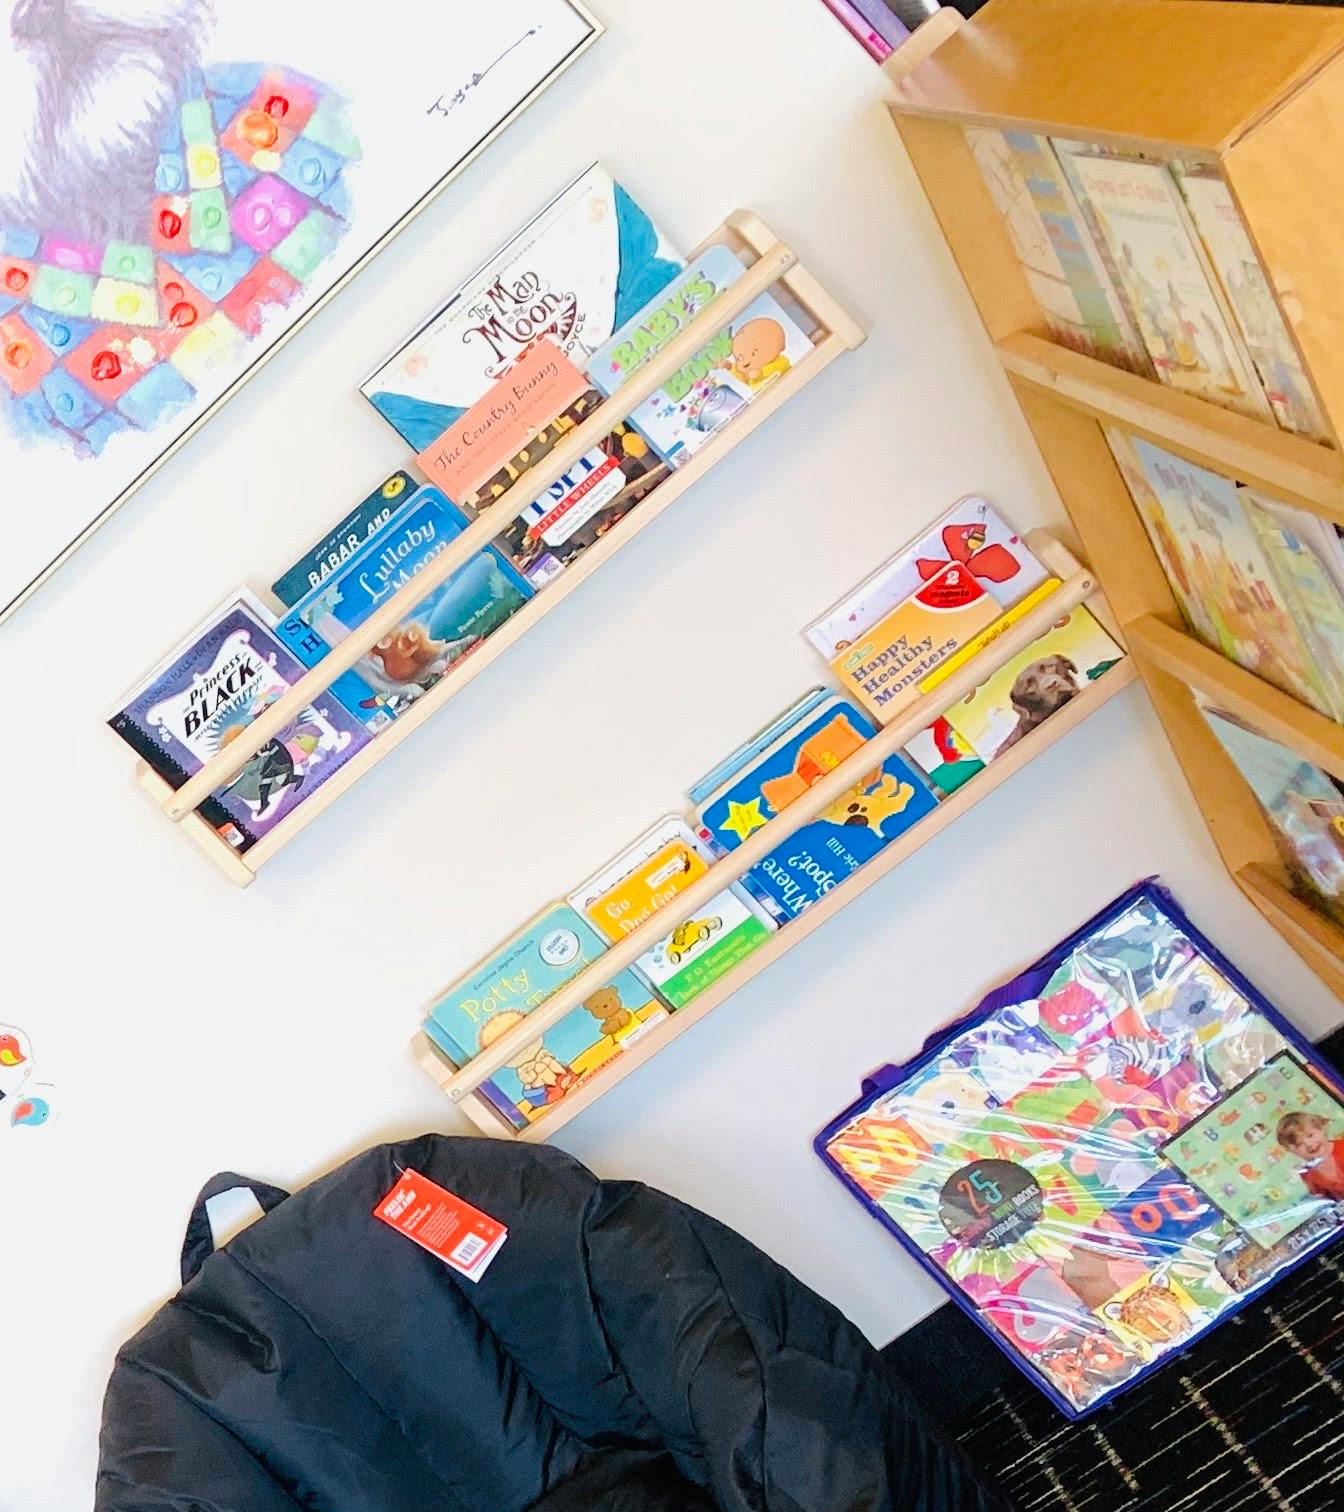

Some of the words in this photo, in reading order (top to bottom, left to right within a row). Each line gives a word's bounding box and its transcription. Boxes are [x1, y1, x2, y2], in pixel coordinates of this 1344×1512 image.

[485, 270, 543, 315] Man
[462, 289, 564, 361] Moon
[608, 272, 715, 373] BABY'S
[433, 446, 461, 471] The
[459, 398, 517, 446] Country
[512, 358, 558, 399] Bunny
[537, 498, 572, 531] LITTLE
[571, 463, 611, 500] WHEELS
[307, 533, 361, 587] BABAR
[366, 507, 391, 536] AND
[361, 517, 438, 602] Lullaby
[188, 654, 242, 705] Princess
[851, 633, 909, 683] Happy
[862, 634, 934, 694] Healthy
[873, 637, 958, 706] Monsters
[183, 656, 256, 738] BLACK
[825, 836, 844, 855] Hill
[604, 897, 631, 920] Go
[459, 966, 530, 1024] Potty
[955, 1167, 1004, 1214] 25
[1011, 1182, 1041, 1207] BOOKS
[985, 1214, 1021, 1242] STORAGE
